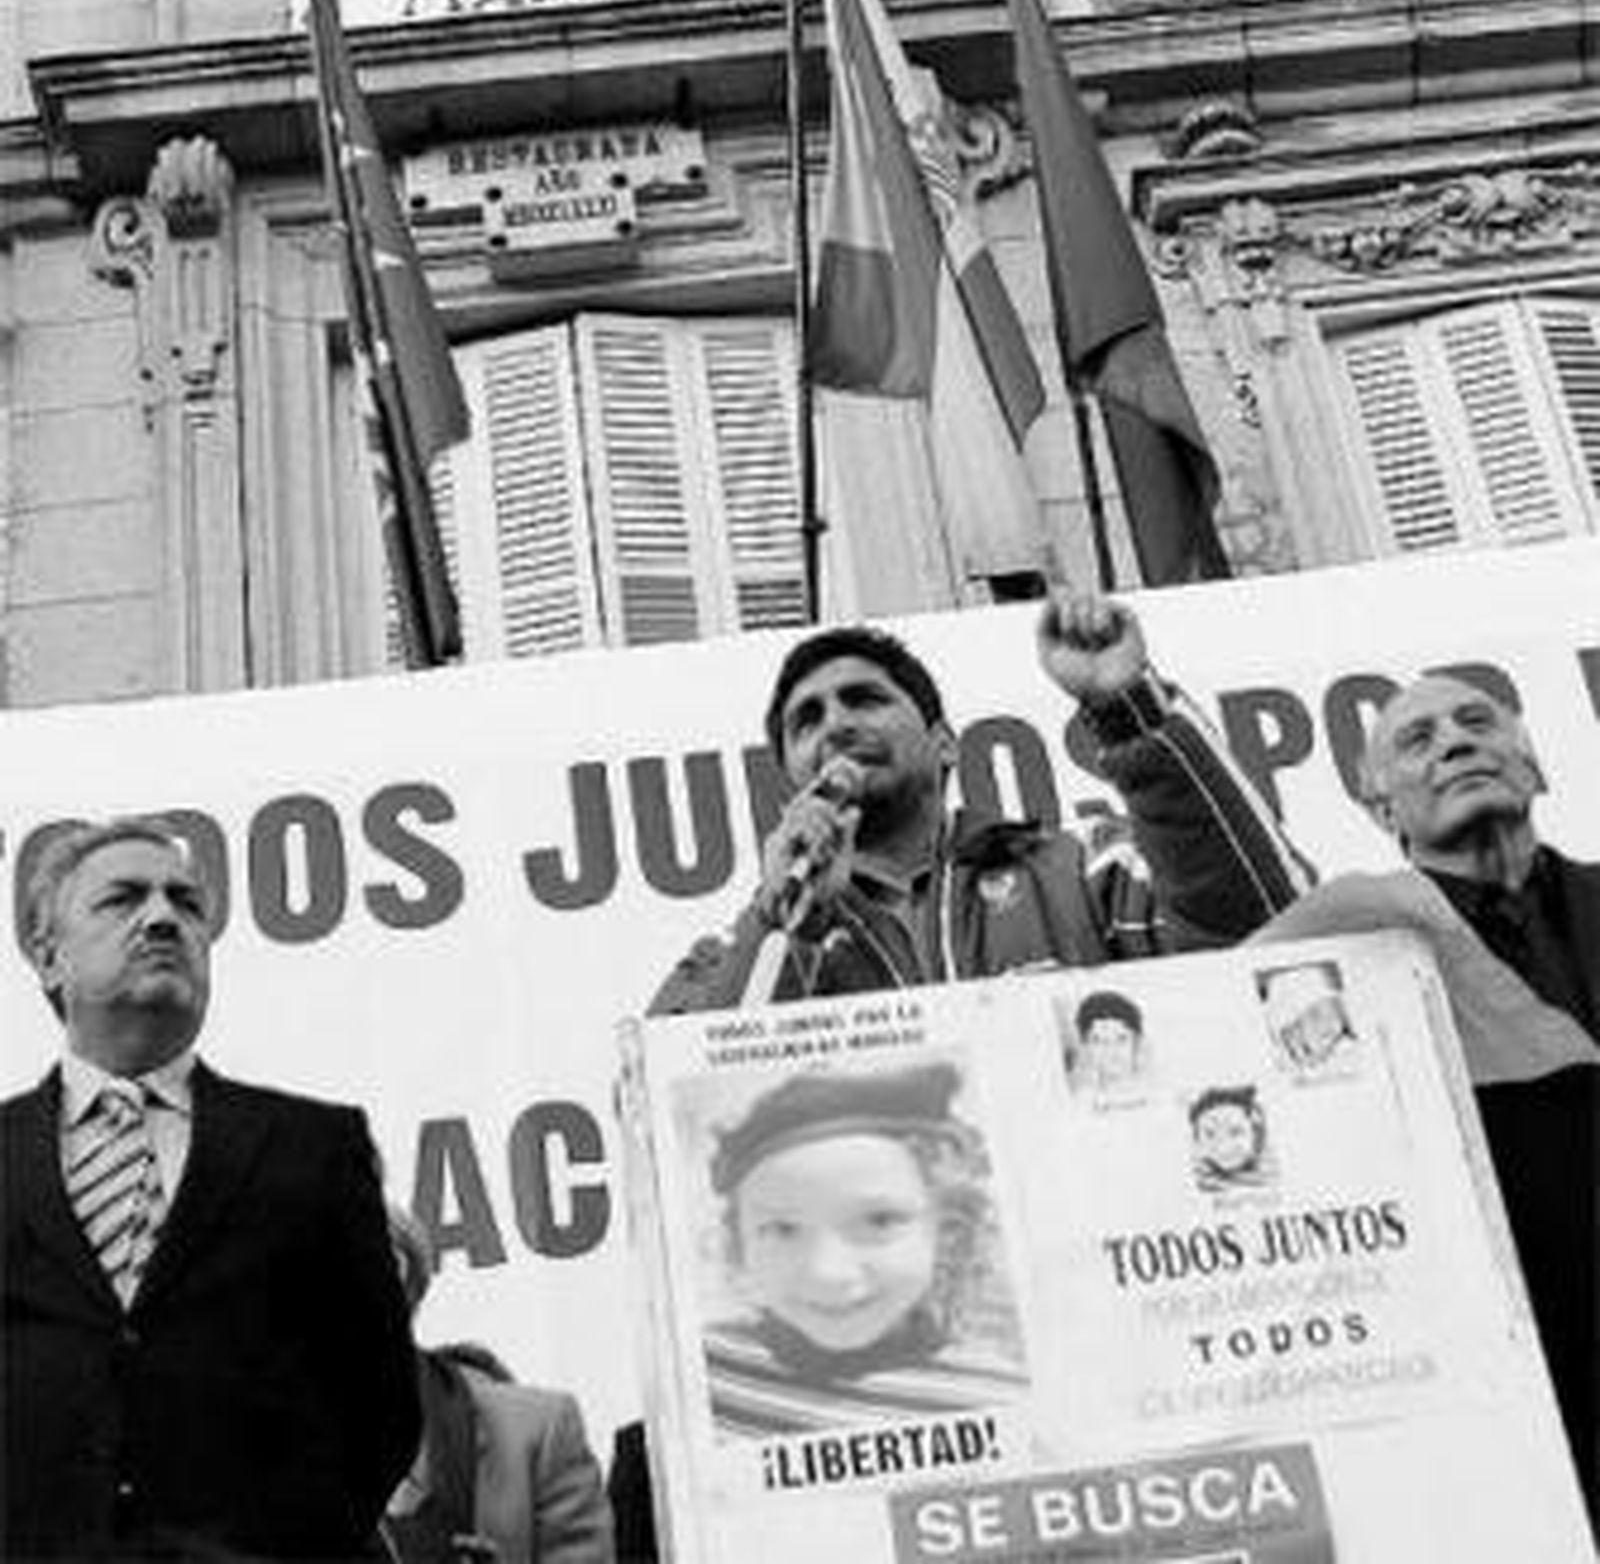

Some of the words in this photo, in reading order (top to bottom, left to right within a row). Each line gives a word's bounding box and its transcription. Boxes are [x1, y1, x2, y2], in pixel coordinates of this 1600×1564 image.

[1103, 1222, 1244, 1288] TODOS
[1259, 1201, 1408, 1267] JUNTOS
[762, 1419, 1001, 1489] ¡LIBERTAD!
[916, 1497, 1008, 1554] SE
[1030, 1462, 1297, 1542] BUSCA
